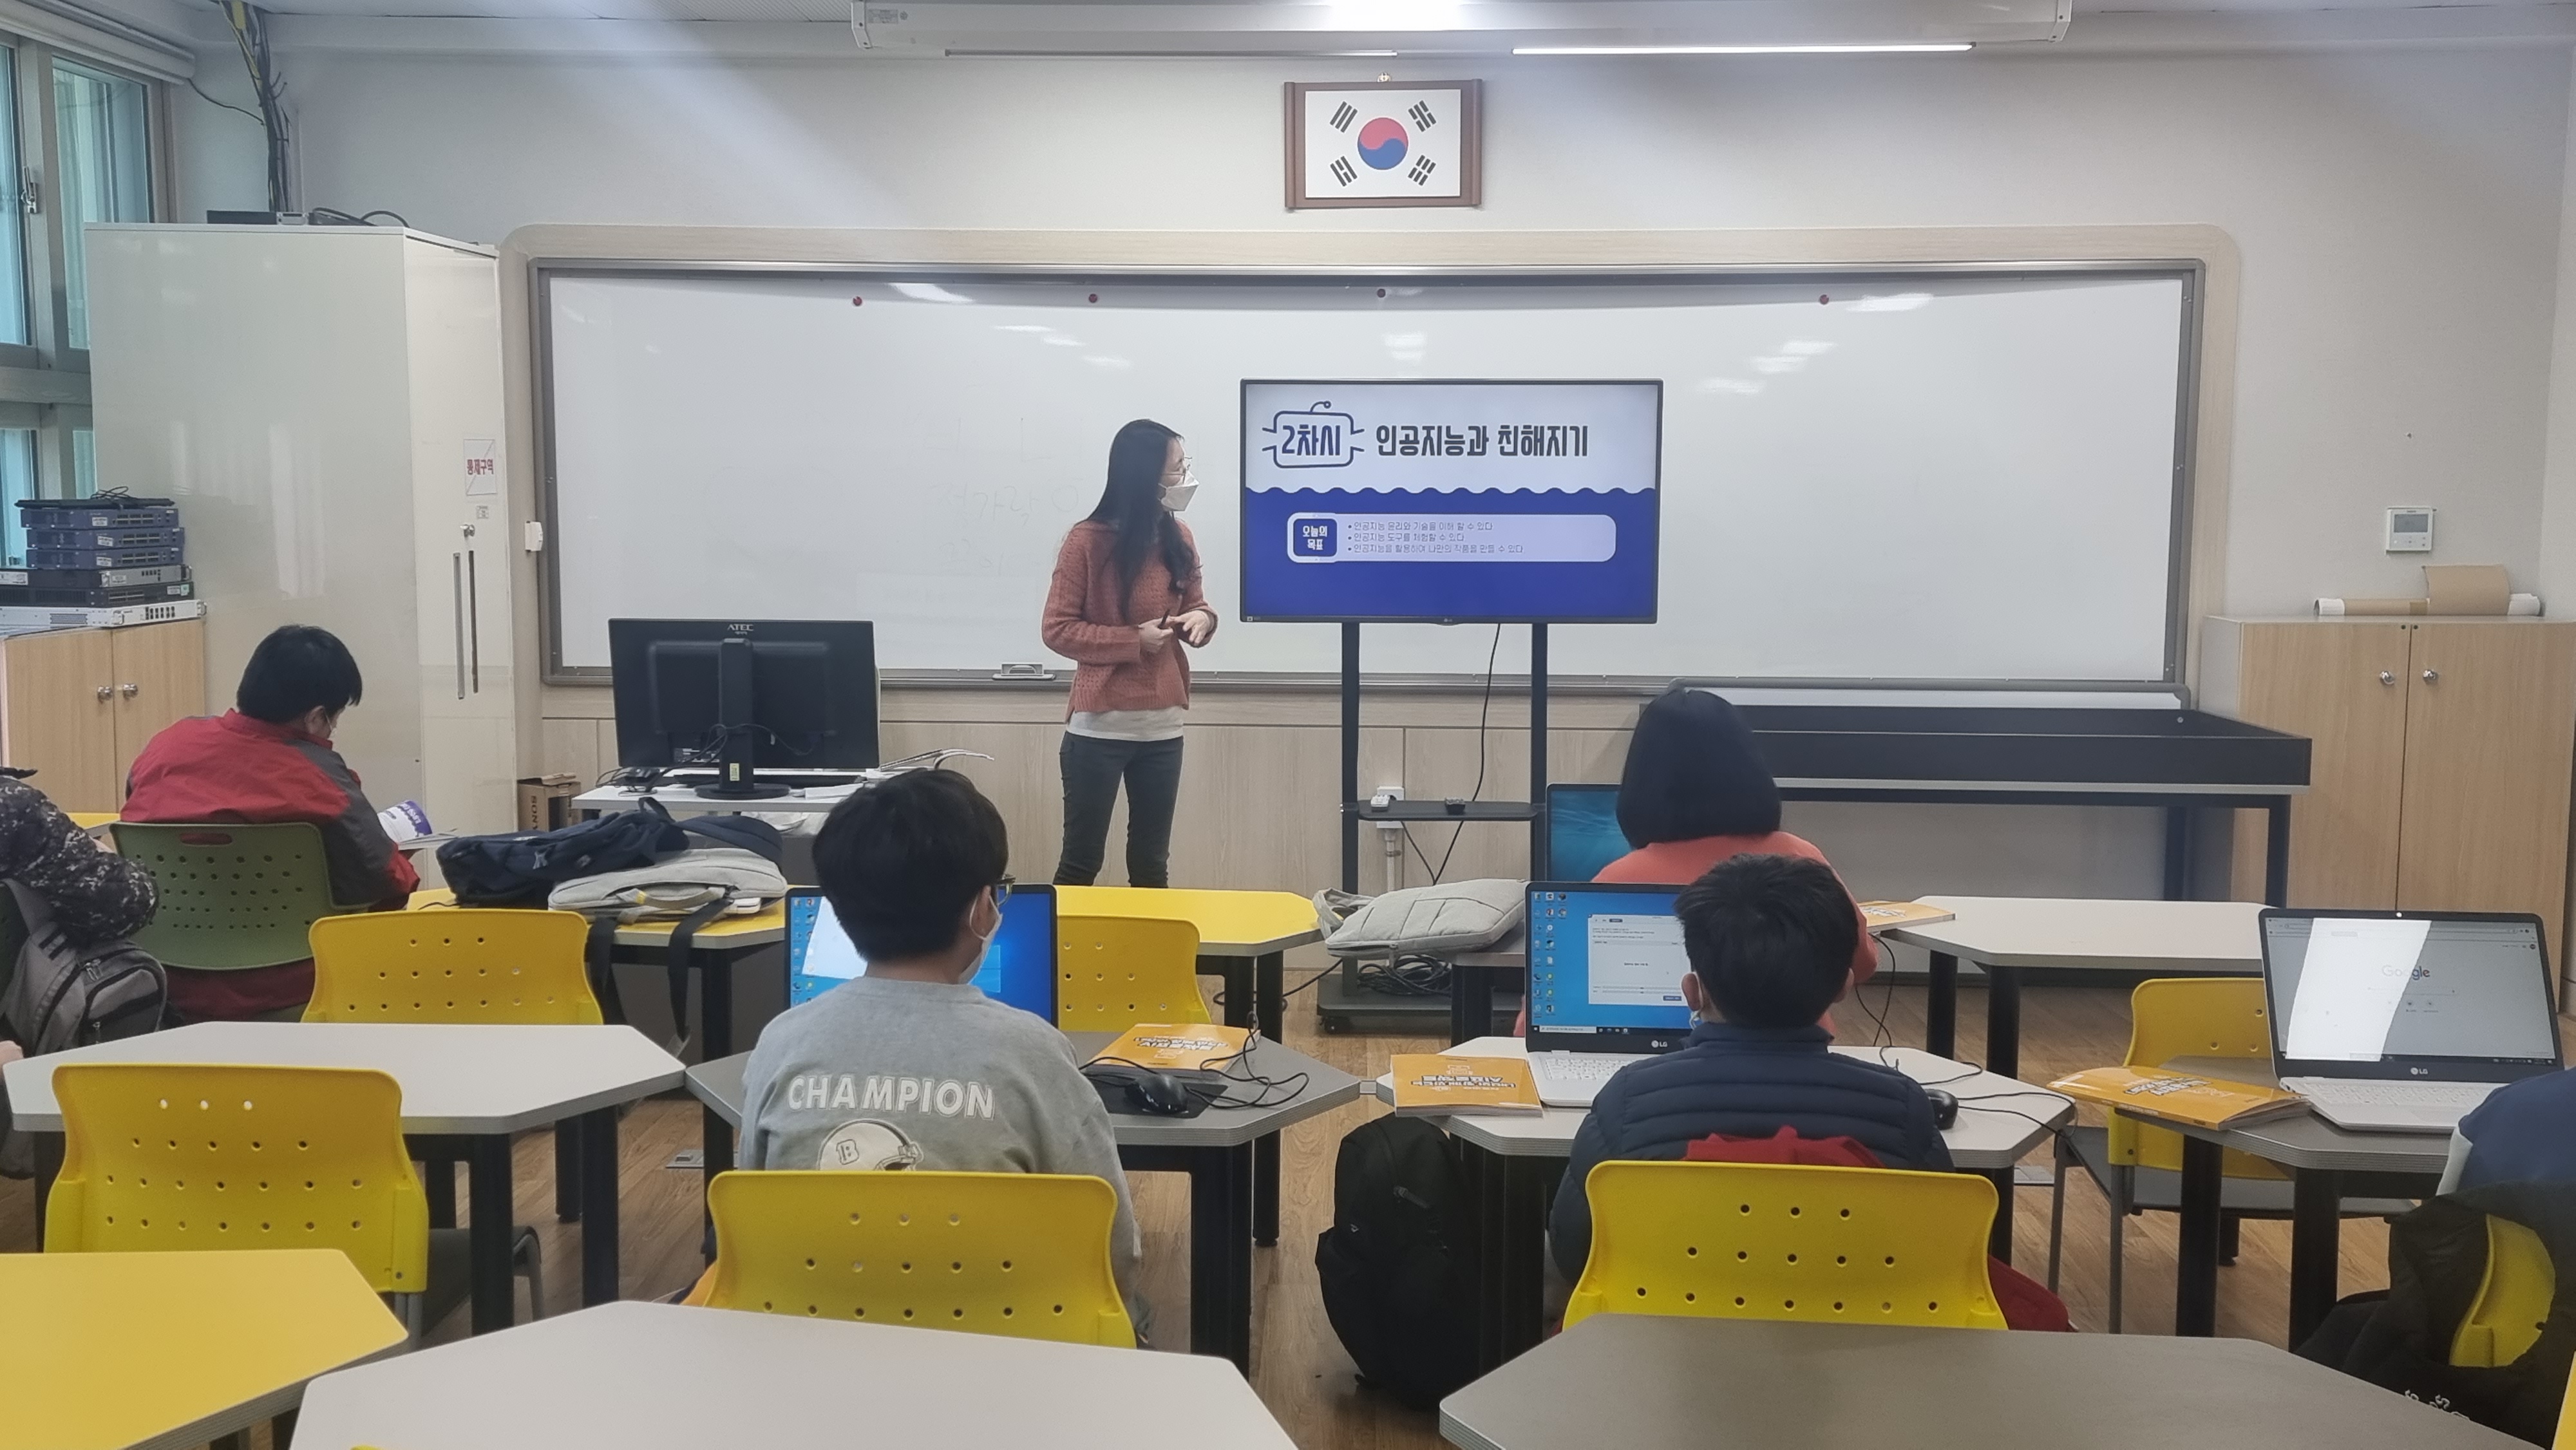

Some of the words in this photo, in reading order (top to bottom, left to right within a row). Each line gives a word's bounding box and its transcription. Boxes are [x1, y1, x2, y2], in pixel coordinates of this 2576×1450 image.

[1282, 424, 1341, 456] 2차시
[1376, 425, 1490, 457] 인공지능과
[1497, 424, 1588, 457] 친해지기
[1302, 525, 1328, 538] 오늘의
[1354, 522, 1385, 531] 인공지능
[1414, 522, 1436, 531] 기술을
[1457, 522, 1465, 531] 할
[1467, 522, 1474, 531] 수
[1354, 532, 1385, 542] 인공지능
[1387, 532, 1410, 542] 도구를
[1439, 533, 1446, 541] 수
[1307, 538, 1324, 551] 목표
[1354, 544, 1392, 553] 인공지능을
[1428, 544, 1452, 553] 나만의
[1498, 545, 1505, 553] 수
[788, 1074, 995, 1120] CHAMPION
[836, 1139, 859, 1165] B
